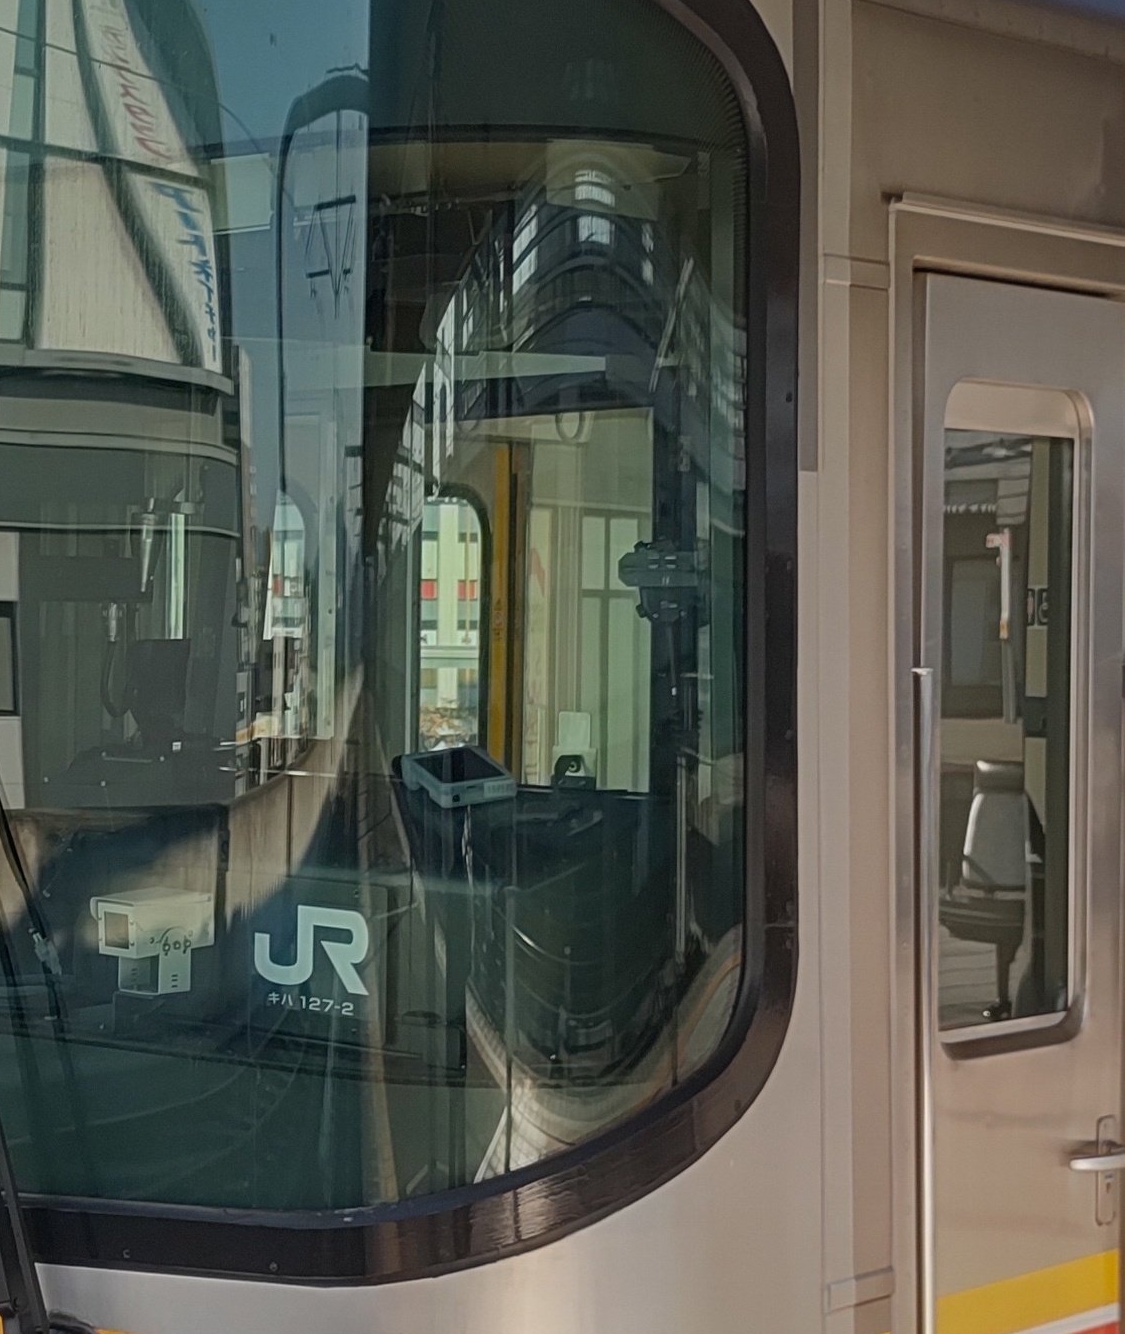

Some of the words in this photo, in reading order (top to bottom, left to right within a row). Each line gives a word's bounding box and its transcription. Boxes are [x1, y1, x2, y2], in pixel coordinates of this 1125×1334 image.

[254, 904, 370, 996] JR
[268, 991, 293, 1007] キハ
[300, 995, 354, 1016] 127-2
